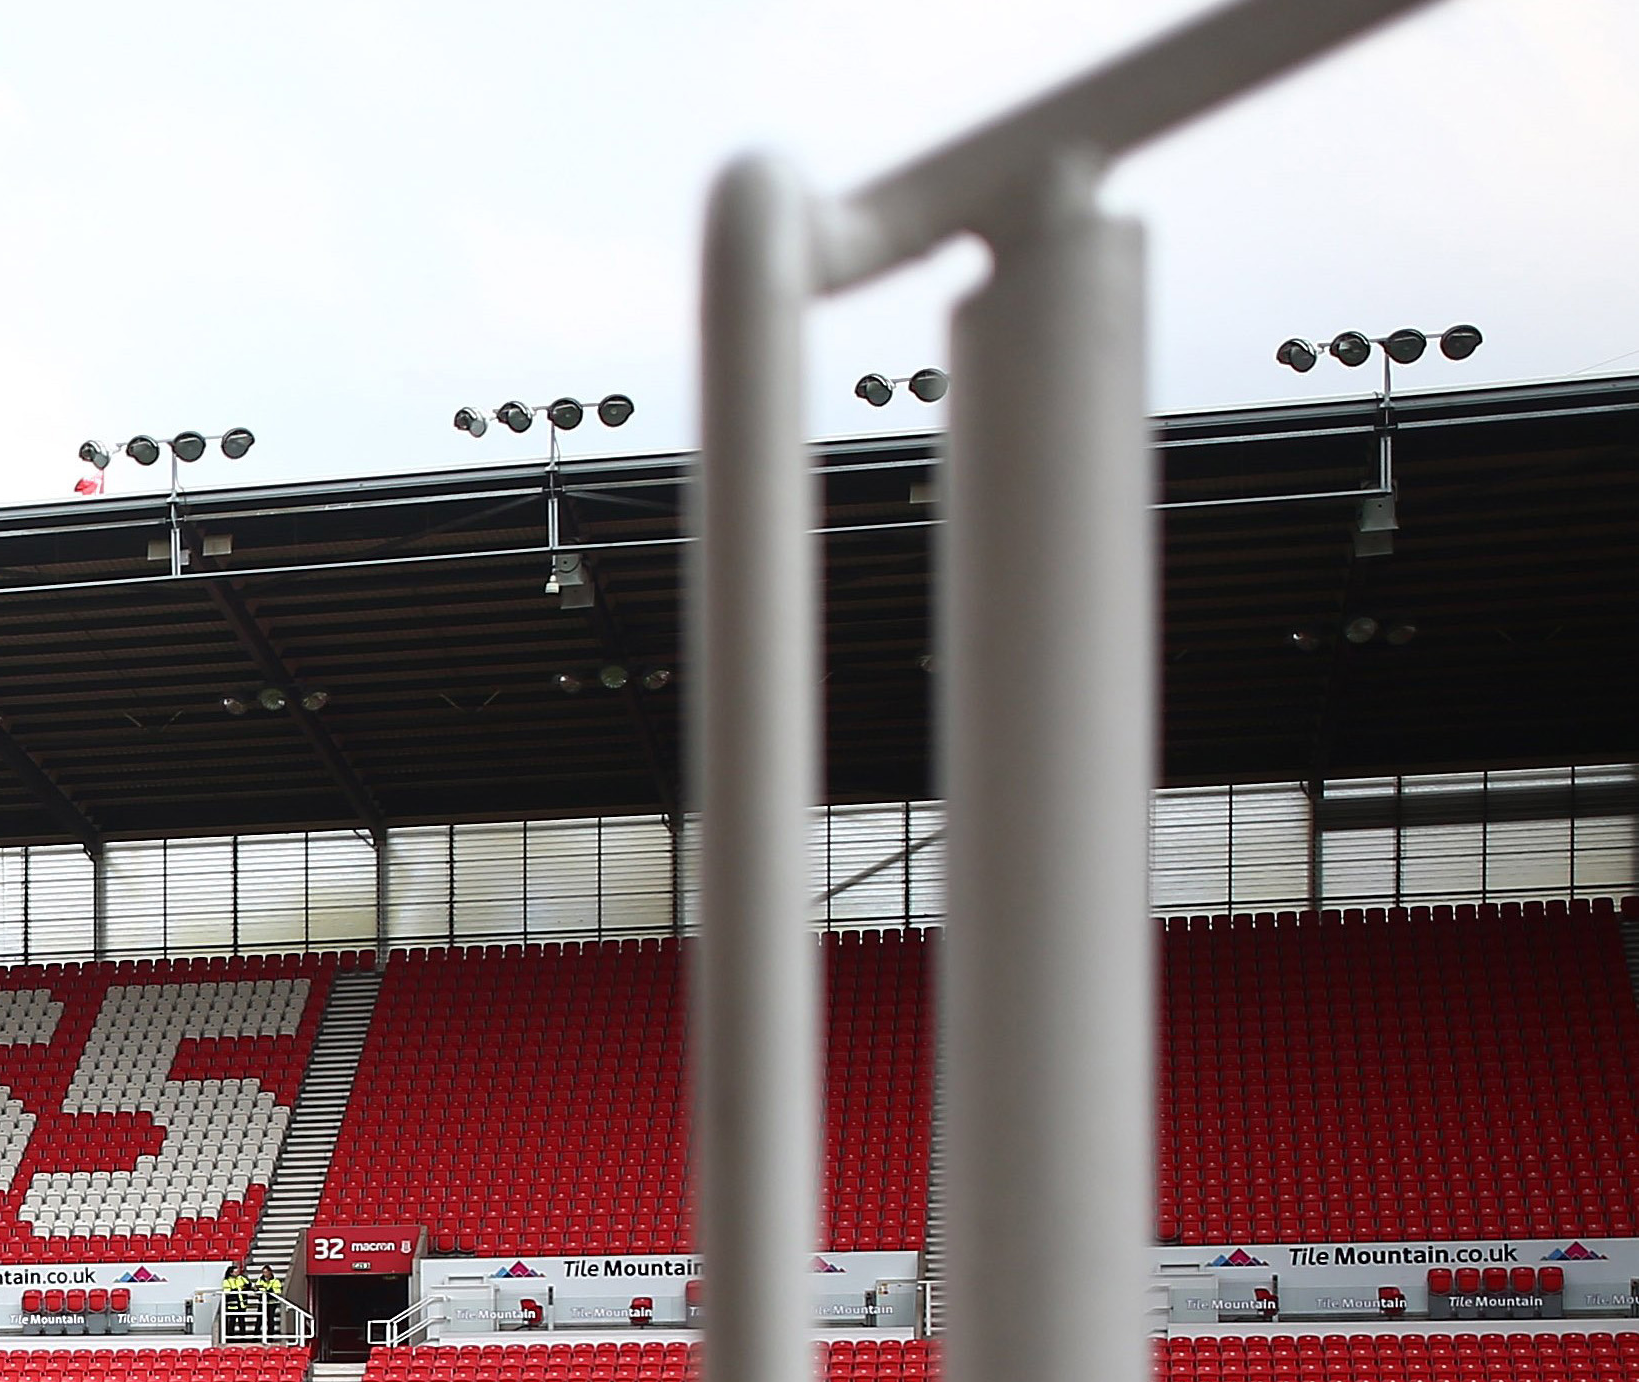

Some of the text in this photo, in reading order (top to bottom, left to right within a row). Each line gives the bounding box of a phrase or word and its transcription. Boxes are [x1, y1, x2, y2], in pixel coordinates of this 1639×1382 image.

[313, 1238, 395, 1260] 32 macron
[1288, 1243, 1519, 1266] Tile Mountain.co.uk
[563, 1257, 704, 1278] Tile Mountain
[1186, 1298, 1277, 1311] Tile Mountain
[1341, 1297, 1407, 1310] Mountain
[1448, 1295, 1544, 1308] Tile Mountain
[477, 1308, 537, 1321] Mountain
[593, 1307, 653, 1319] Mountain
[832, 1303, 894, 1316] Mountain
[10, 1313, 85, 1326] Tile Mountain
[117, 1312, 194, 1325] Tile Mountain
